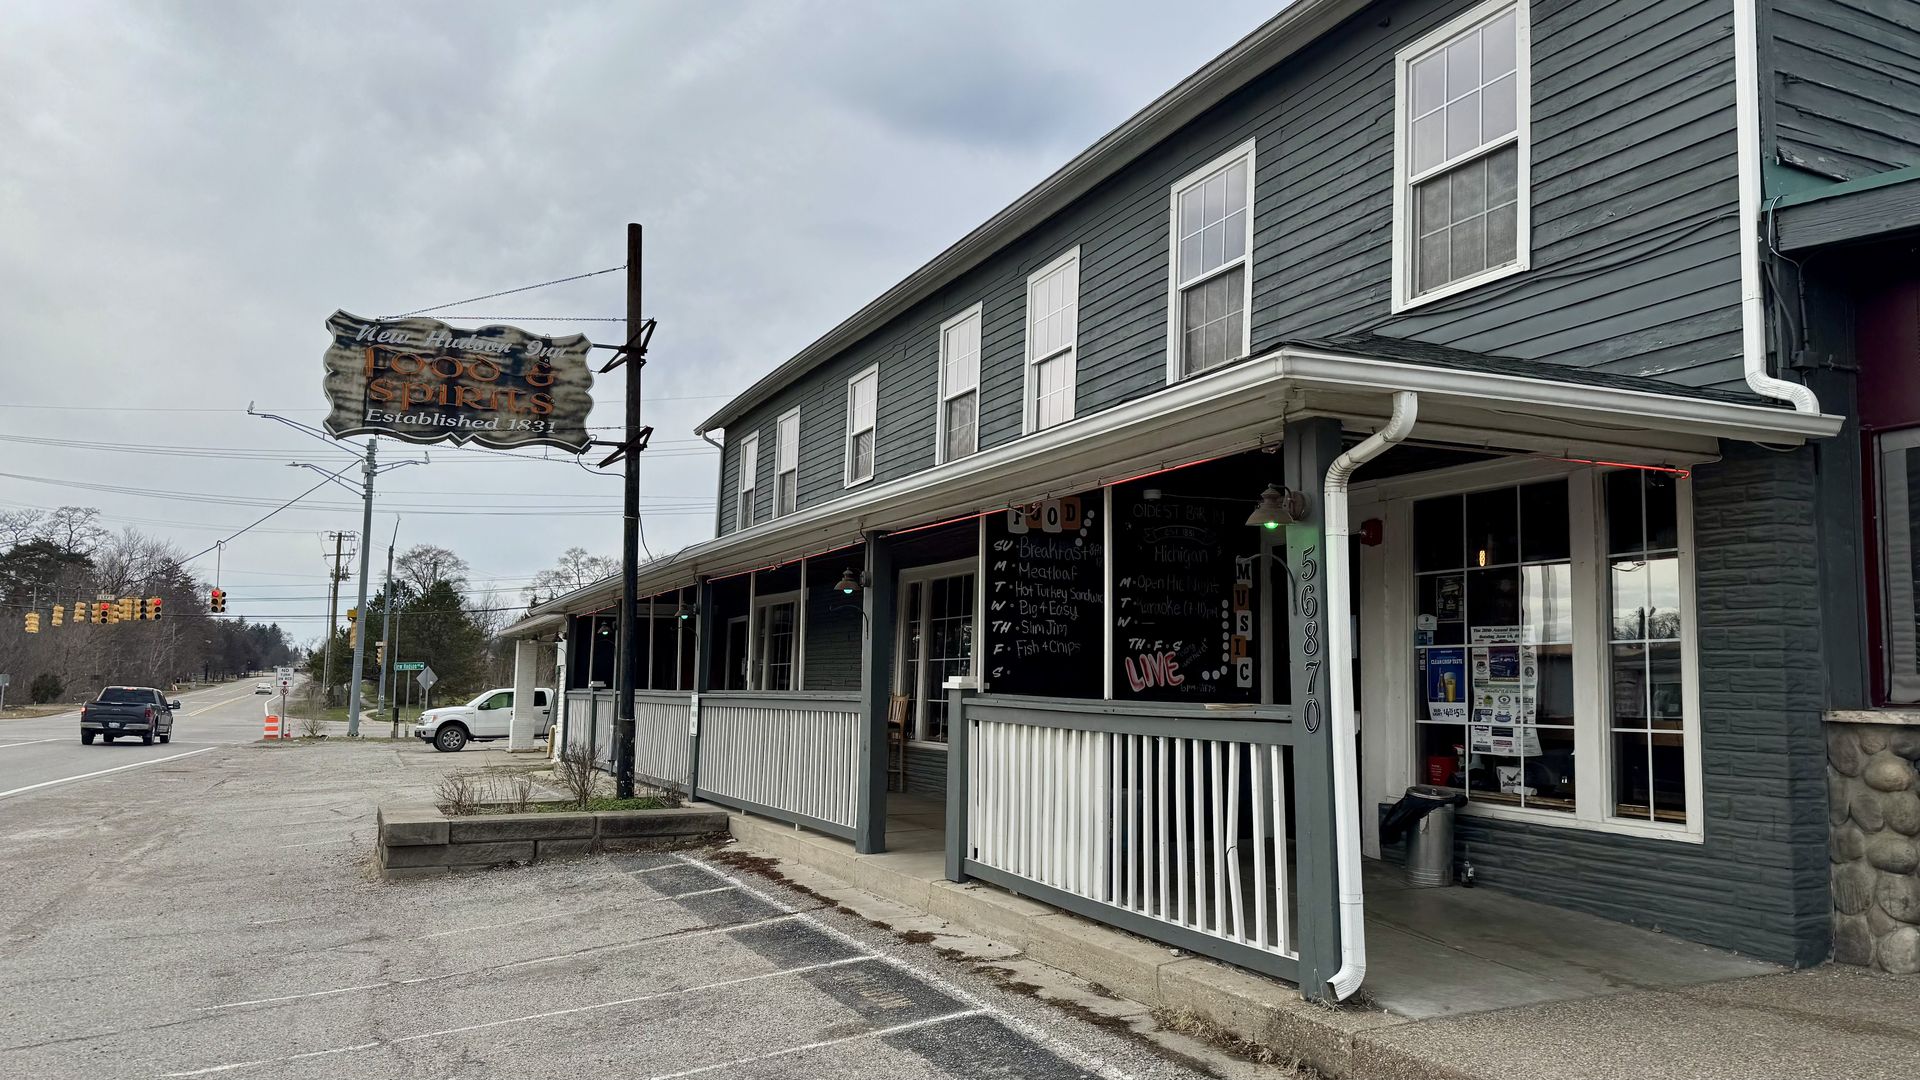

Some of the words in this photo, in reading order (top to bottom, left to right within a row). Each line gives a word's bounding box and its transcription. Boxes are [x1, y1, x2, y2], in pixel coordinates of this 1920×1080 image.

[355, 324, 410, 344] New
[424, 329, 512, 354] Hudson
[525, 340, 568, 358] Inn
[365, 408, 506, 431] Established
[507, 417, 556, 435] 1831
[993, 560, 1007, 572] M
[1018, 562, 1079, 582] Meatloaf
[994, 581, 1007, 593] T
[1015, 580, 1034, 598] Hot
[1034, 583, 1069, 604] Turkey
[1136, 574, 1165, 593] Open
[990, 600, 1007, 612] W
[1019, 599, 1038, 618] Big
[1049, 600, 1080, 621] Easy
[1233, 561, 1251, 681] MUSIC
[991, 620, 1013, 634] TH
[1021, 619, 1045, 635] Slim
[1045, 619, 1069, 636] Jim
[992, 643, 1005, 656] F
[1015, 640, 1040, 659] Fish
[1048, 640, 1082, 657] Chips
[1300, 544, 1322, 735] 56870
[991, 665, 1004, 679] S
[1124, 650, 1185, 693] LIVE
